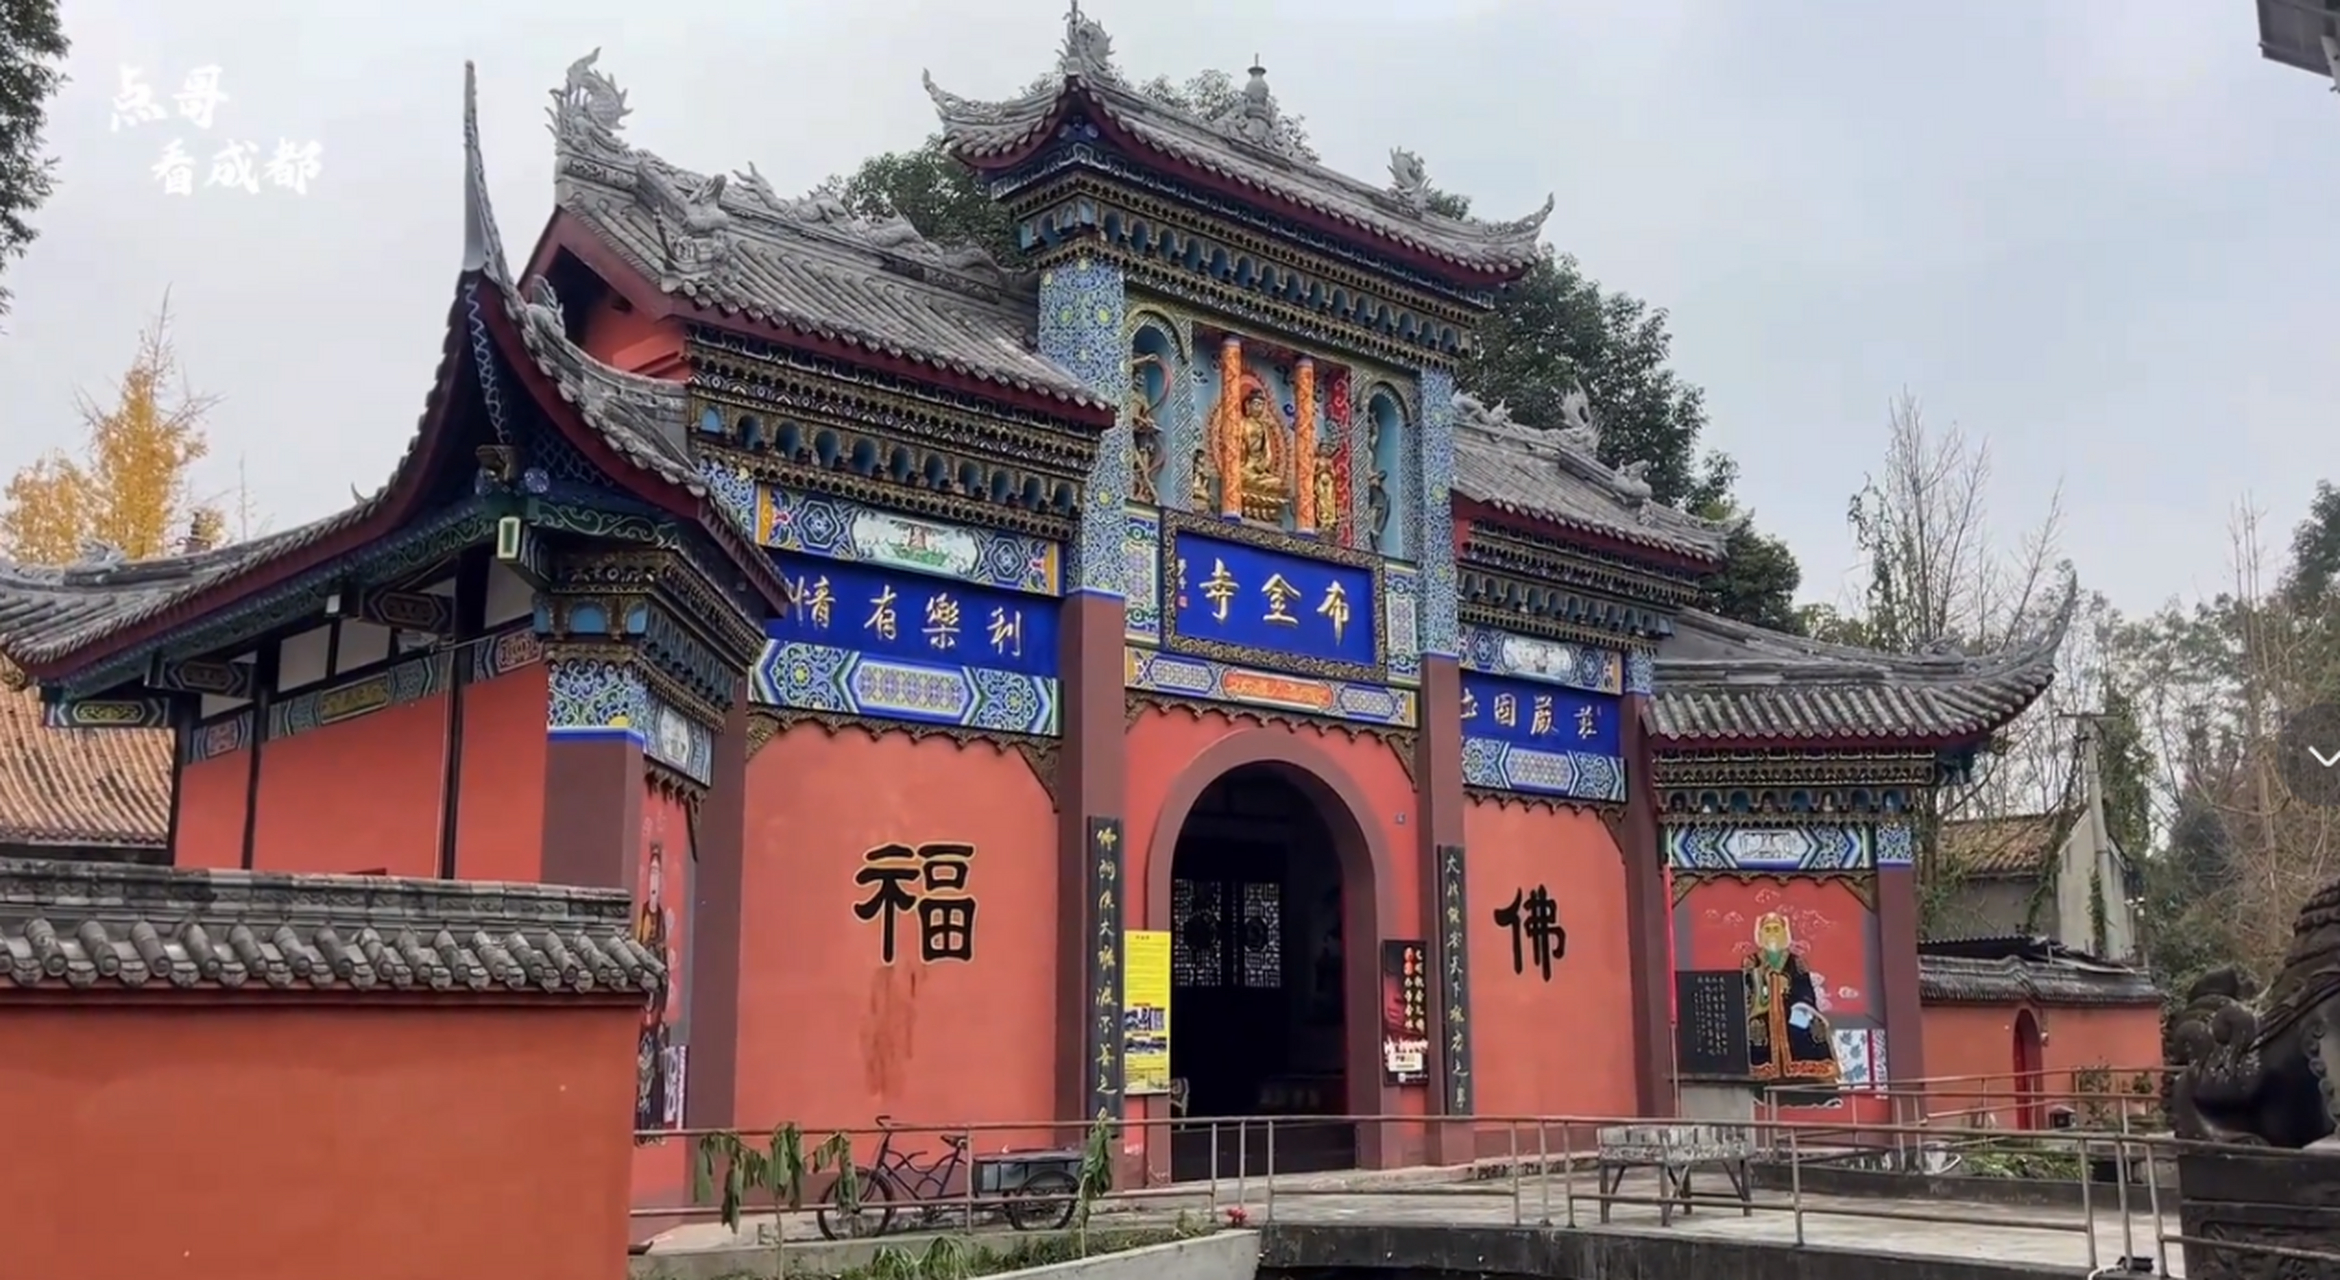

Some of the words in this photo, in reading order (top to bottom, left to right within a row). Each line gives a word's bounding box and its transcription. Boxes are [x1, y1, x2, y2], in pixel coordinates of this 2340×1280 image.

[1198, 556, 1350, 646] 布金寺
[853, 843, 977, 963] 福
[1493, 883, 1566, 983] 佛
